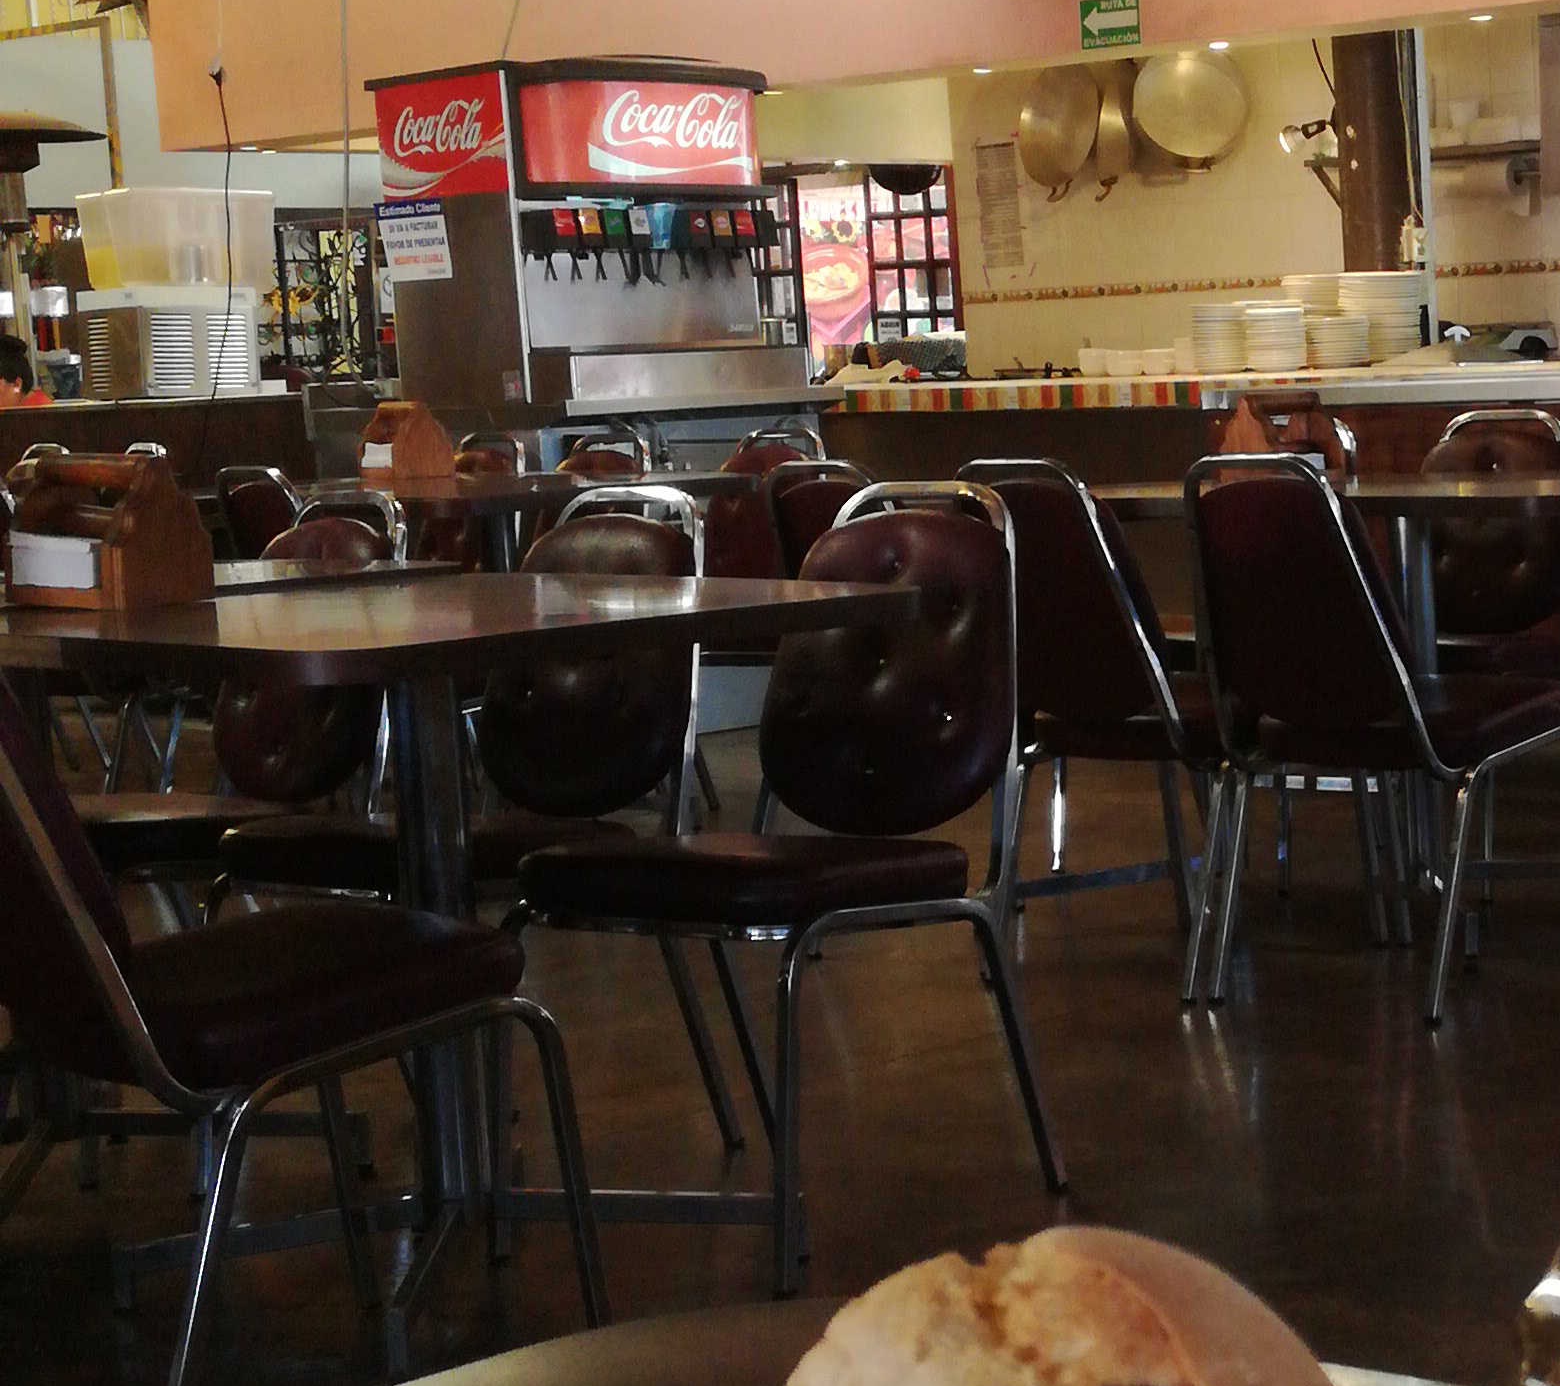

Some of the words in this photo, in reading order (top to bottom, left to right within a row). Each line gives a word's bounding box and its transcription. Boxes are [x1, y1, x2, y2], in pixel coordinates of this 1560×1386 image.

[1100, 0, 1124, 10] RUTA
[1083, 32, 1139, 48] EVACUACIÓN
[602, 89, 744, 149] Coca-Cola
[394, 97, 486, 157] Coca-Cola
[378, 205, 415, 217] Estimado
[415, 203, 441, 214] Cliente
[410, 221, 439, 231] FACTURAR
[386, 240, 405, 250] FAVOR
[406, 239, 413, 249] DE
[414, 237, 446, 248] PRESENTAR
